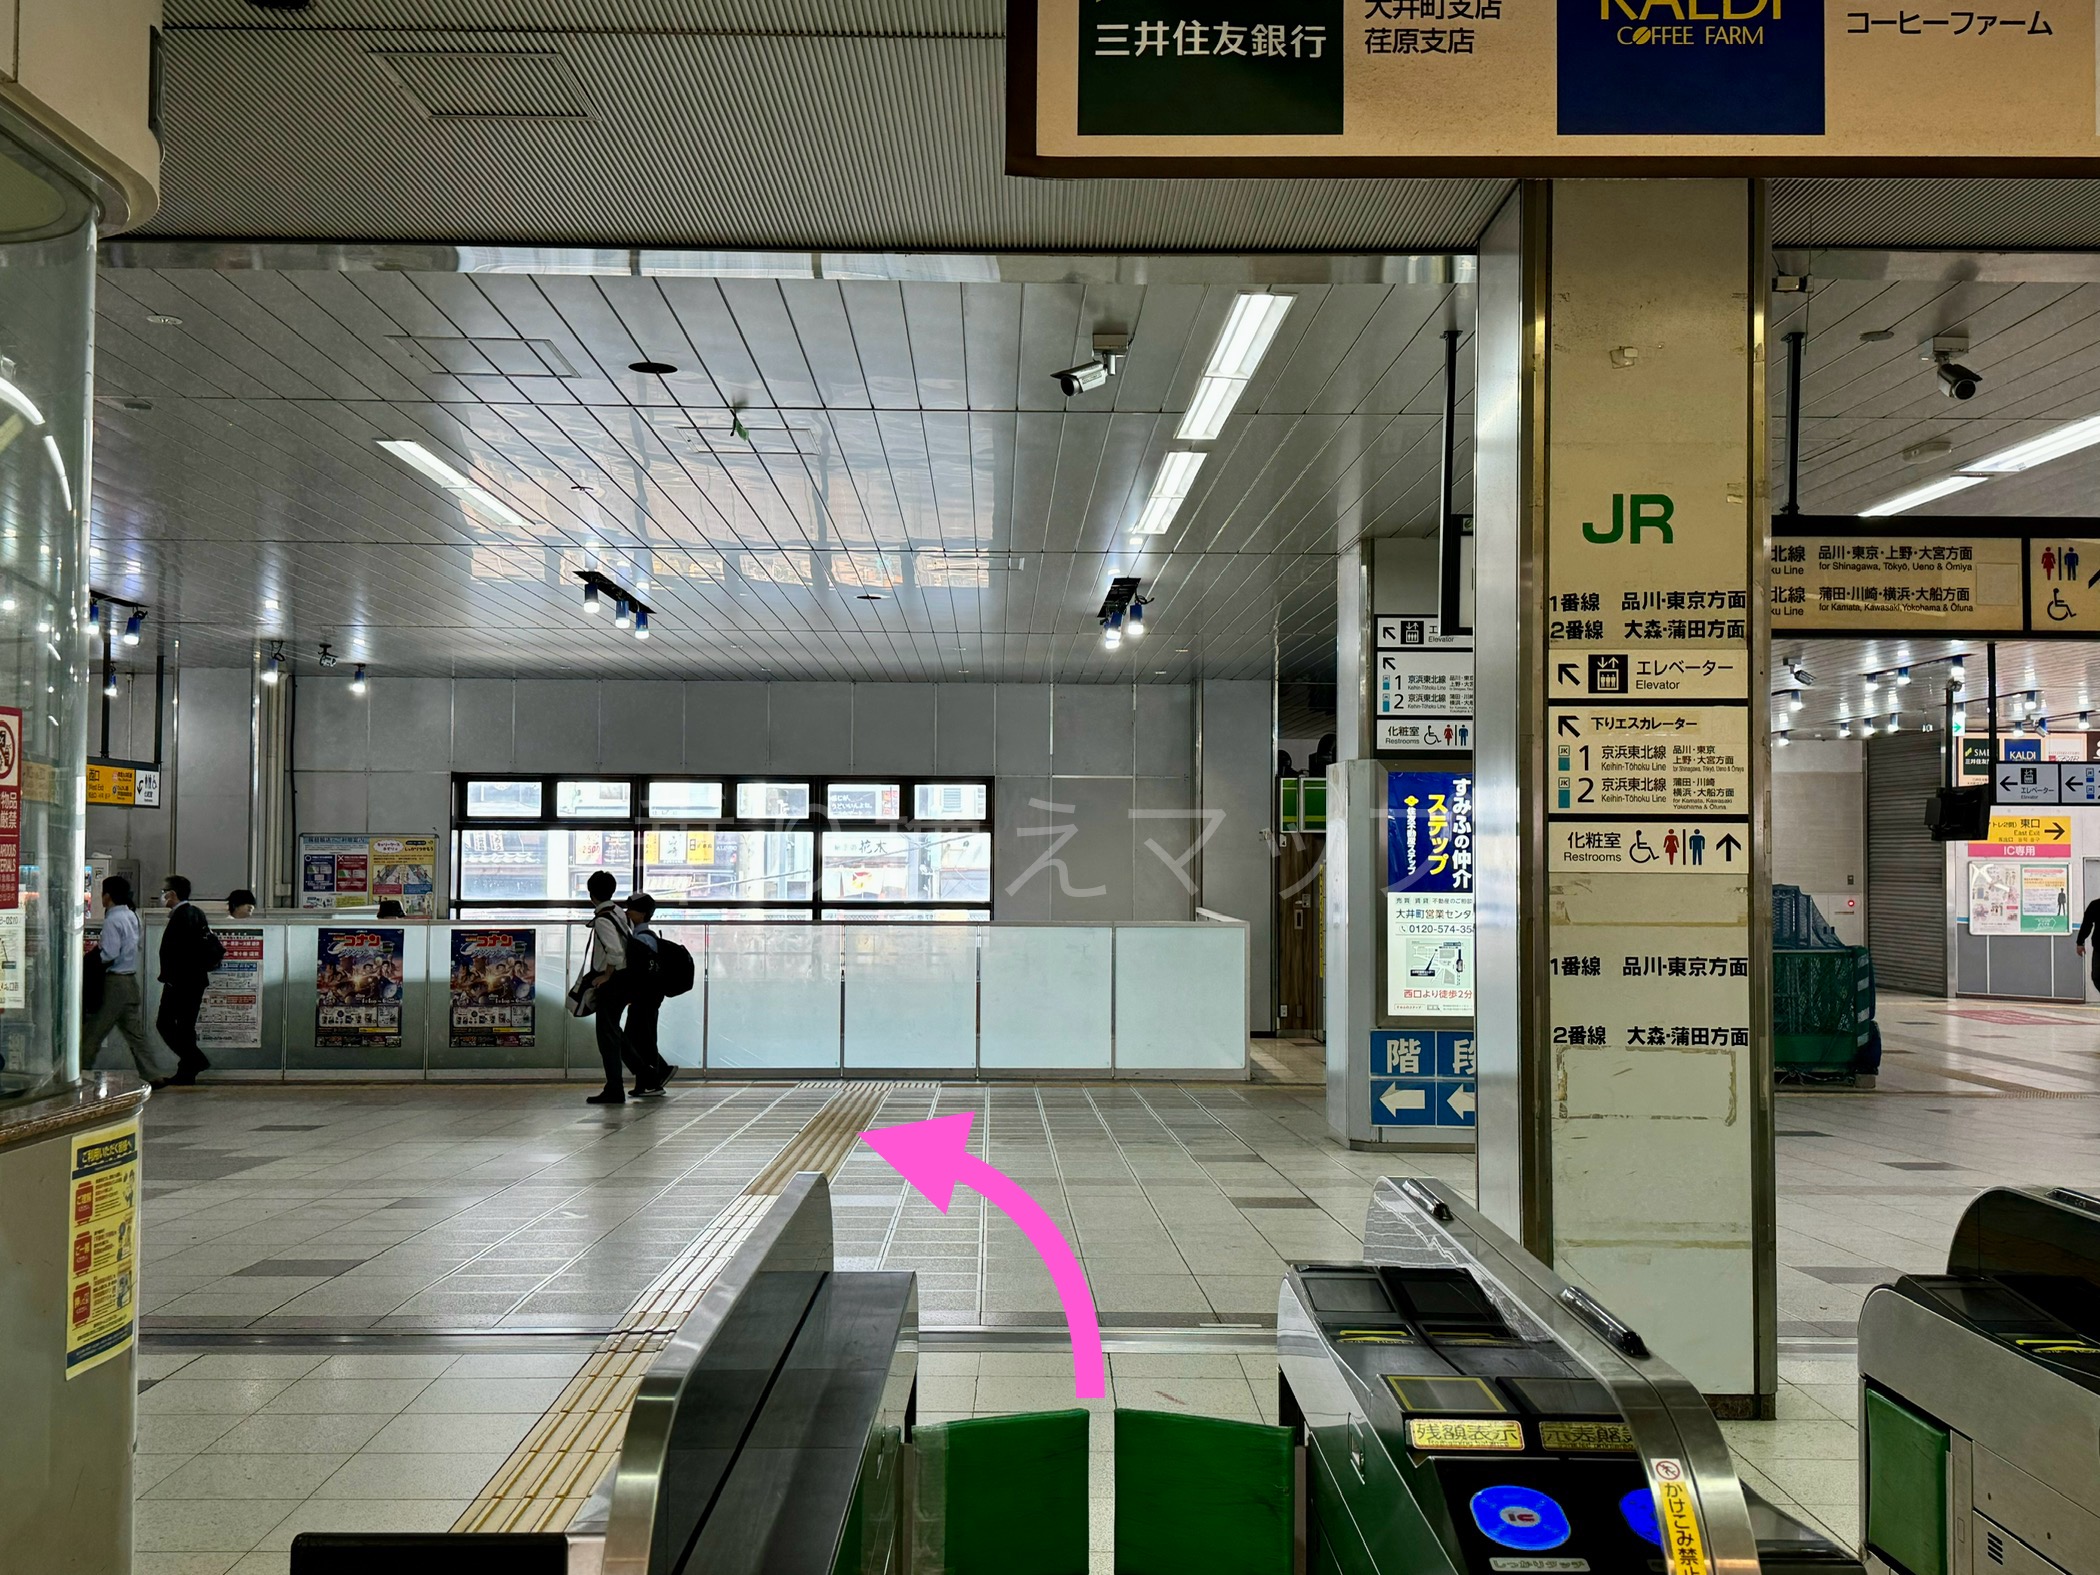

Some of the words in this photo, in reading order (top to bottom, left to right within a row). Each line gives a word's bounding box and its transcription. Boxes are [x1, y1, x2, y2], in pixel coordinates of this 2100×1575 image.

[1846, 11, 2054, 36] コーヒーファーム
[1095, 20, 1326, 58] 三井住友銀行
[1365, 28, 1474, 55] 荏原支店
[1617, 26, 1694, 46] COFFEE
[1705, 26, 1764, 45] FARM
[1582, 494, 1674, 544] JR
[1819, 545, 1973, 560] 品川・東京・上野・大宮方面
[1784, 564, 1804, 575] Line
[1819, 562, 1829, 570] for
[1832, 562, 1880, 572] Shinagawa,
[1912, 562, 1934, 571] Ueno
[1937, 562, 1944, 571] &
[1819, 586, 1970, 601] 蒲田・川崎・横浜・大船方面
[1550, 593, 1600, 612] 1番線
[1621, 591, 1747, 611] 品川・東京方面
[1784, 605, 1804, 616] Line
[1819, 603, 1829, 611] for
[1943, 603, 1949, 612] &
[1550, 620, 1604, 640] 2番線
[1624, 619, 1745, 640] 大森・蒲田方面
[1636, 659, 1734, 677] エレベーター
[1395, 675, 1401, 690] 1
[1635, 680, 1681, 690] Elevator
[1394, 694, 1404, 709] 2
[1590, 716, 1697, 731] 下りエスカレーター
[1388, 726, 1419, 737] 化粧室
[1579, 745, 1590, 771] 1
[1601, 745, 1666, 760] 京浜東北線
[1673, 745, 1715, 754] 品川・東京
[1673, 756, 1734, 765] 上野・大宮方面
[2009, 751, 2036, 760] KALDI
[1652, 762, 1666, 771] Line
[1577, 778, 1594, 803] 2
[1601, 777, 1666, 792] 京浜東北線
[1673, 778, 1715, 787] 蒲田・川崎
[1673, 788, 1734, 797] 横浜・大船方面
[1652, 794, 1666, 803] Line
[2021, 818, 2040, 829] 東口
[1427, 794, 1449, 875] ステップ
[1452, 778, 1472, 888] すみふの仲介
[1568, 831, 1621, 850] 化粧室
[1564, 852, 1622, 862] Restrooms
[2004, 846, 2036, 856] IC専用
[1409, 924, 1474, 933] 0120-574-35
[344, 934, 381, 947] コナン
[476, 934, 513, 947] コナン
[1550, 956, 1601, 976] 1番線
[1623, 956, 1748, 976] 品川・東京方面
[1404, 989, 1472, 999] 西口より徒歩2分
[1553, 1026, 1606, 1046] 2番線
[1627, 1026, 1748, 1047] 大森・蒲田方面
[1387, 1038, 1475, 1075] 階段
[1417, 1423, 1519, 1441] 残額表示
[1492, 1558, 1586, 1569] しっかりタッチ
